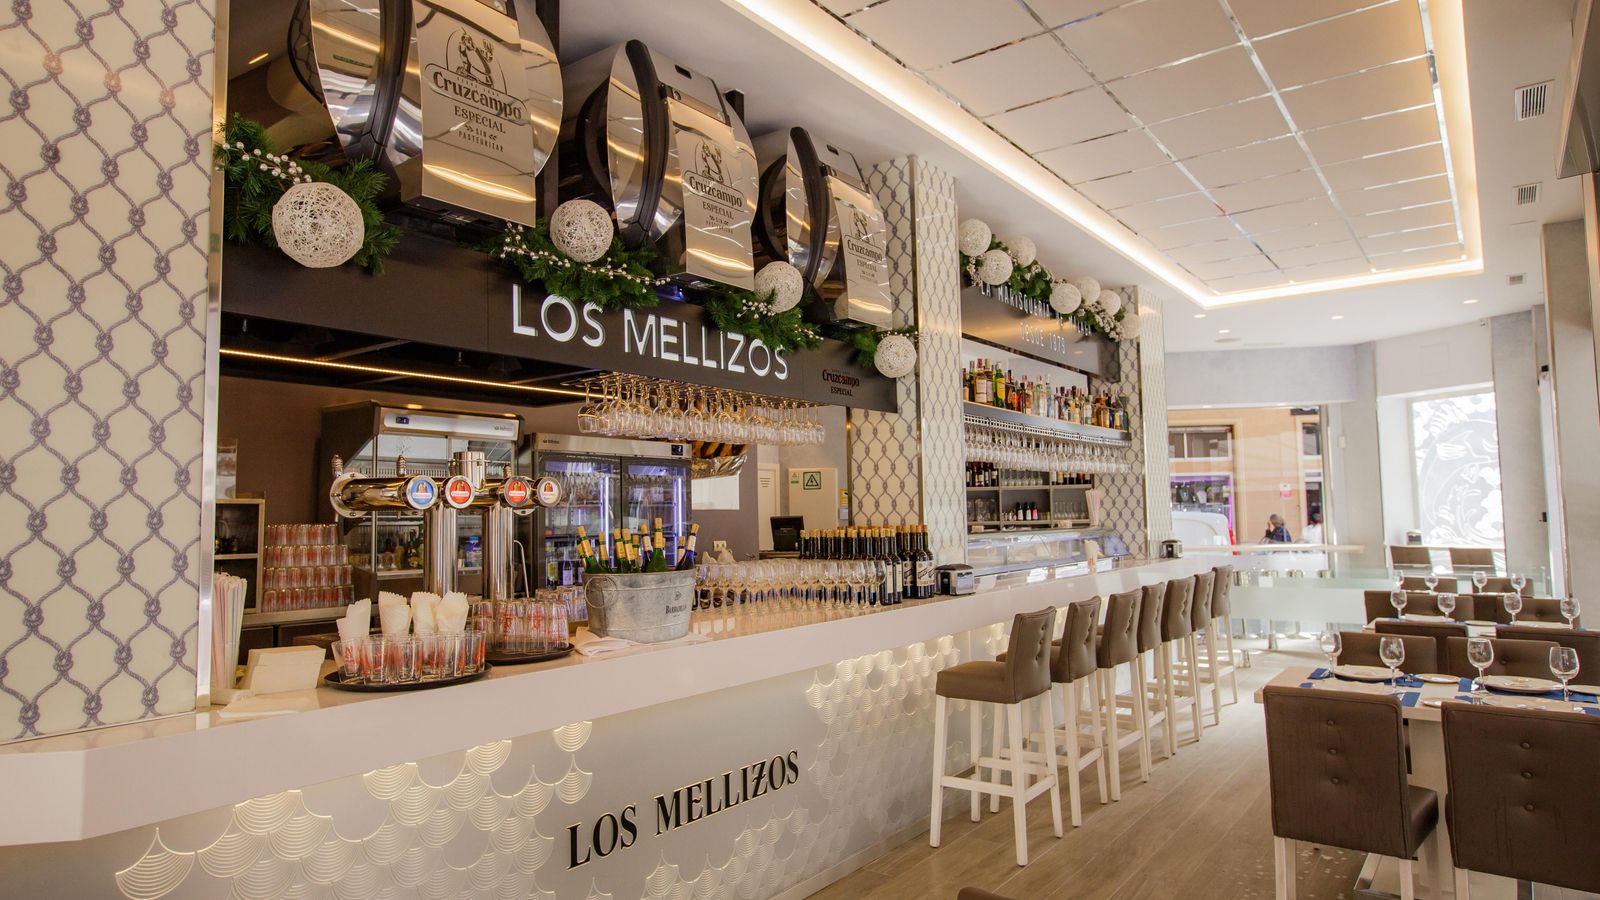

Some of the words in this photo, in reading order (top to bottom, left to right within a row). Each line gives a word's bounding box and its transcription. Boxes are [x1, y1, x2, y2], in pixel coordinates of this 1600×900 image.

[433, 71, 522, 121] Cruzcampo
[454, 106, 506, 134] ESPECIAL
[689, 176, 742, 208] Cruzcampo
[702, 201, 734, 220] ESPECIAL
[847, 239, 882, 262] Cruzcampo
[512, 283, 606, 348] LOS
[624, 308, 790, 381] MELLIZOS
[1019, 321, 1044, 347] DESDE
[822, 369, 860, 388] Cruzcampo
[830, 386, 853, 397] ESPECIAL
[567, 804, 638, 869] LOS
